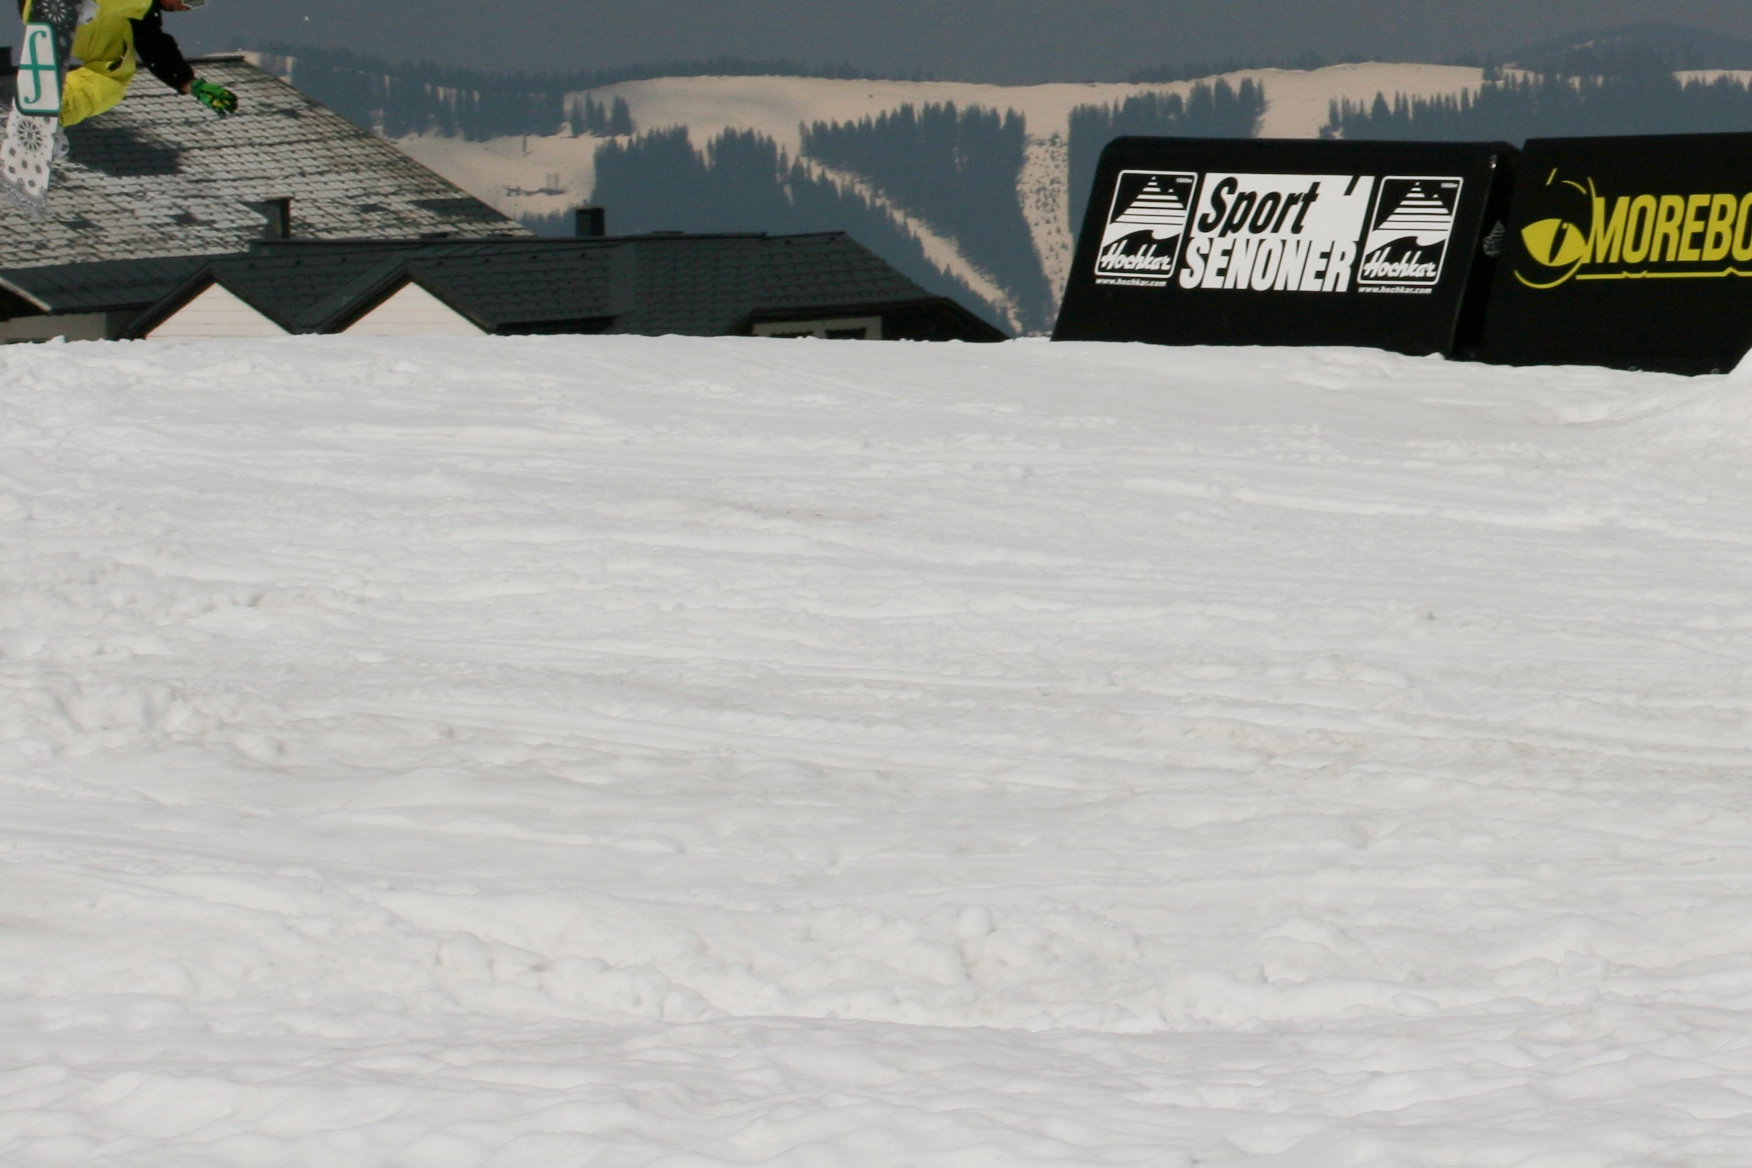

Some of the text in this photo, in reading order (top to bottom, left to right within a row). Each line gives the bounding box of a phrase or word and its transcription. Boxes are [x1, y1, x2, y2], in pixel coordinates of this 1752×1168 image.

[1198, 177, 1321, 238] Sport
[1100, 239, 1171, 270] Hochkar
[1179, 235, 1357, 292] SENONER
[1363, 246, 1437, 278] Hochkar
